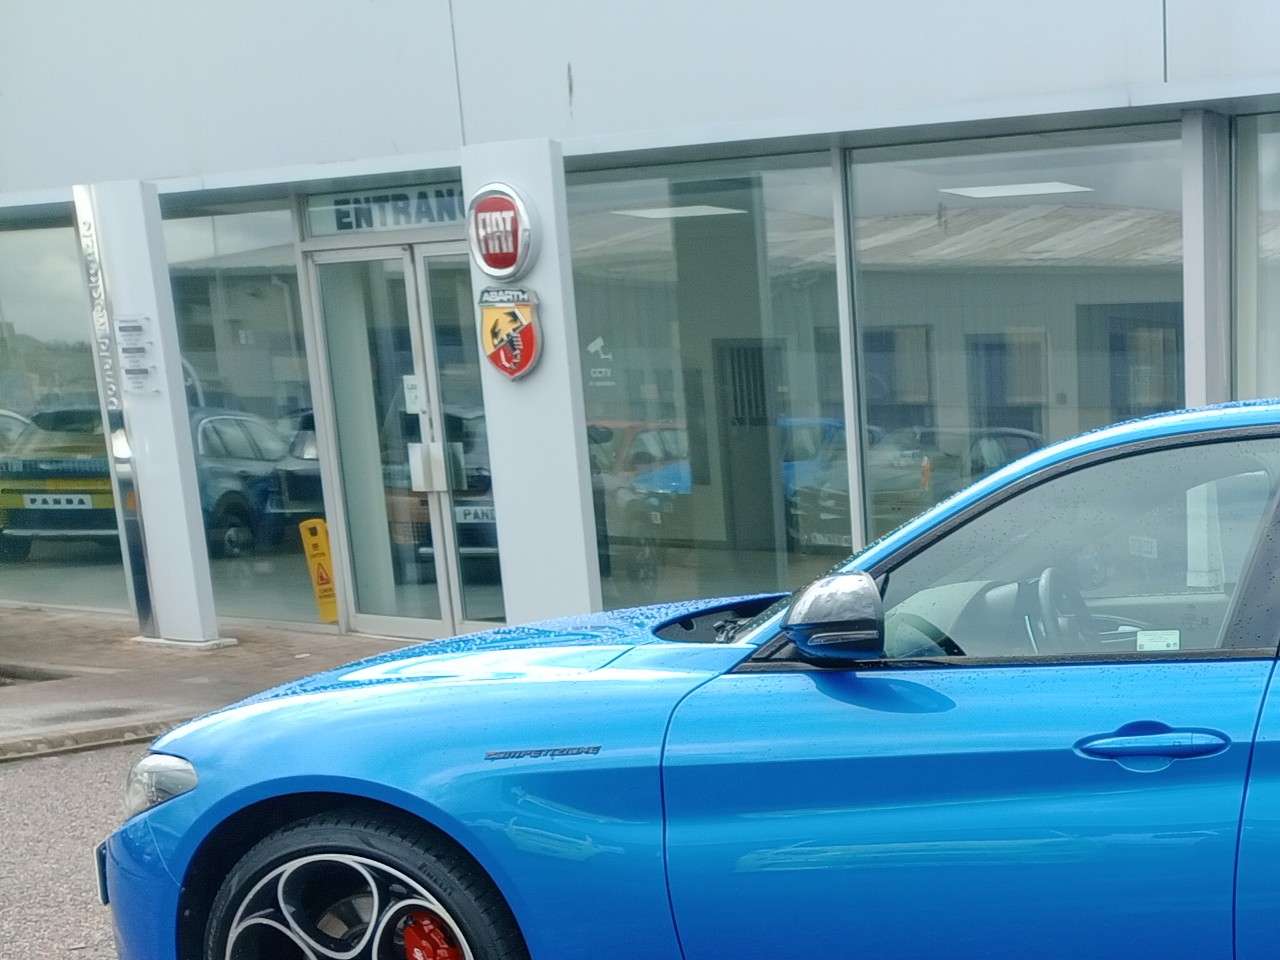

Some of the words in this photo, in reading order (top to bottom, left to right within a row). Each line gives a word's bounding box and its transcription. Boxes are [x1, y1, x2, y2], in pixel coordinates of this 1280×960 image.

[334, 188, 465, 230] ENTRAN
[477, 210, 515, 255] FIAT
[481, 290, 530, 302] ABARTH
[29, 497, 86, 506] PANDA
